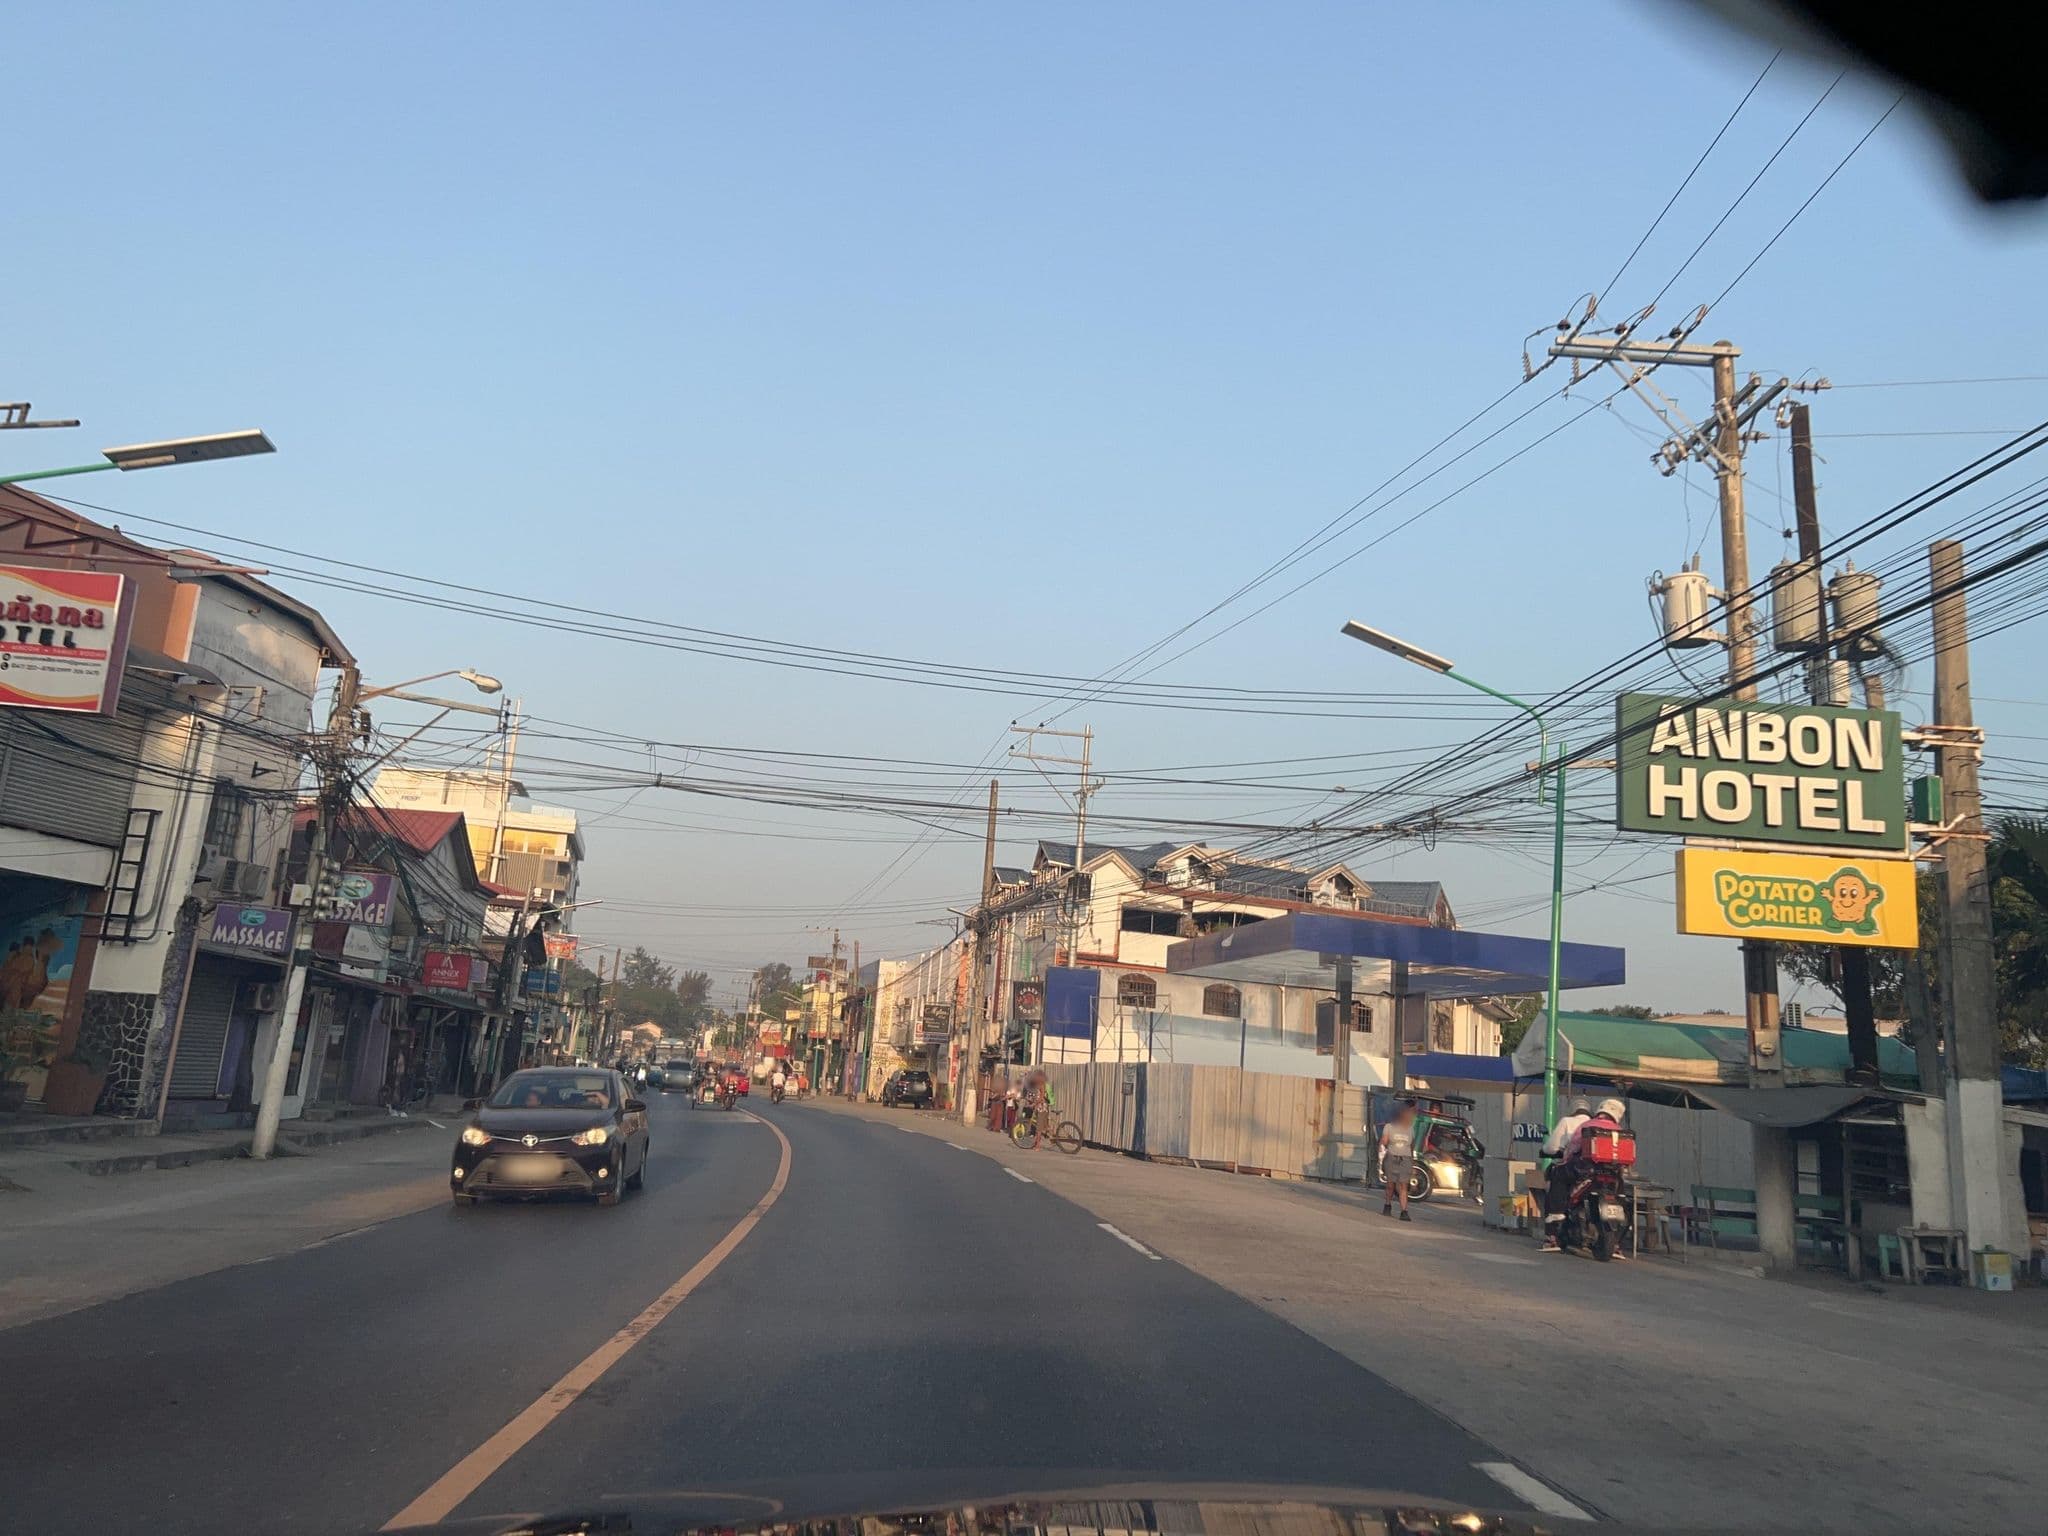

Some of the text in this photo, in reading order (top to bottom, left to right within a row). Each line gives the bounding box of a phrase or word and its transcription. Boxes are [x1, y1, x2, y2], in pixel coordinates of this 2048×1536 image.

[1649, 702, 1884, 772] ANBON
[1648, 764, 1887, 834] HOTEL
[1718, 875, 1816, 904] POTATO
[1727, 898, 1824, 927] CORNER
[212, 924, 285, 950] MASSAGE
[1512, 1123, 1524, 1138] NO
